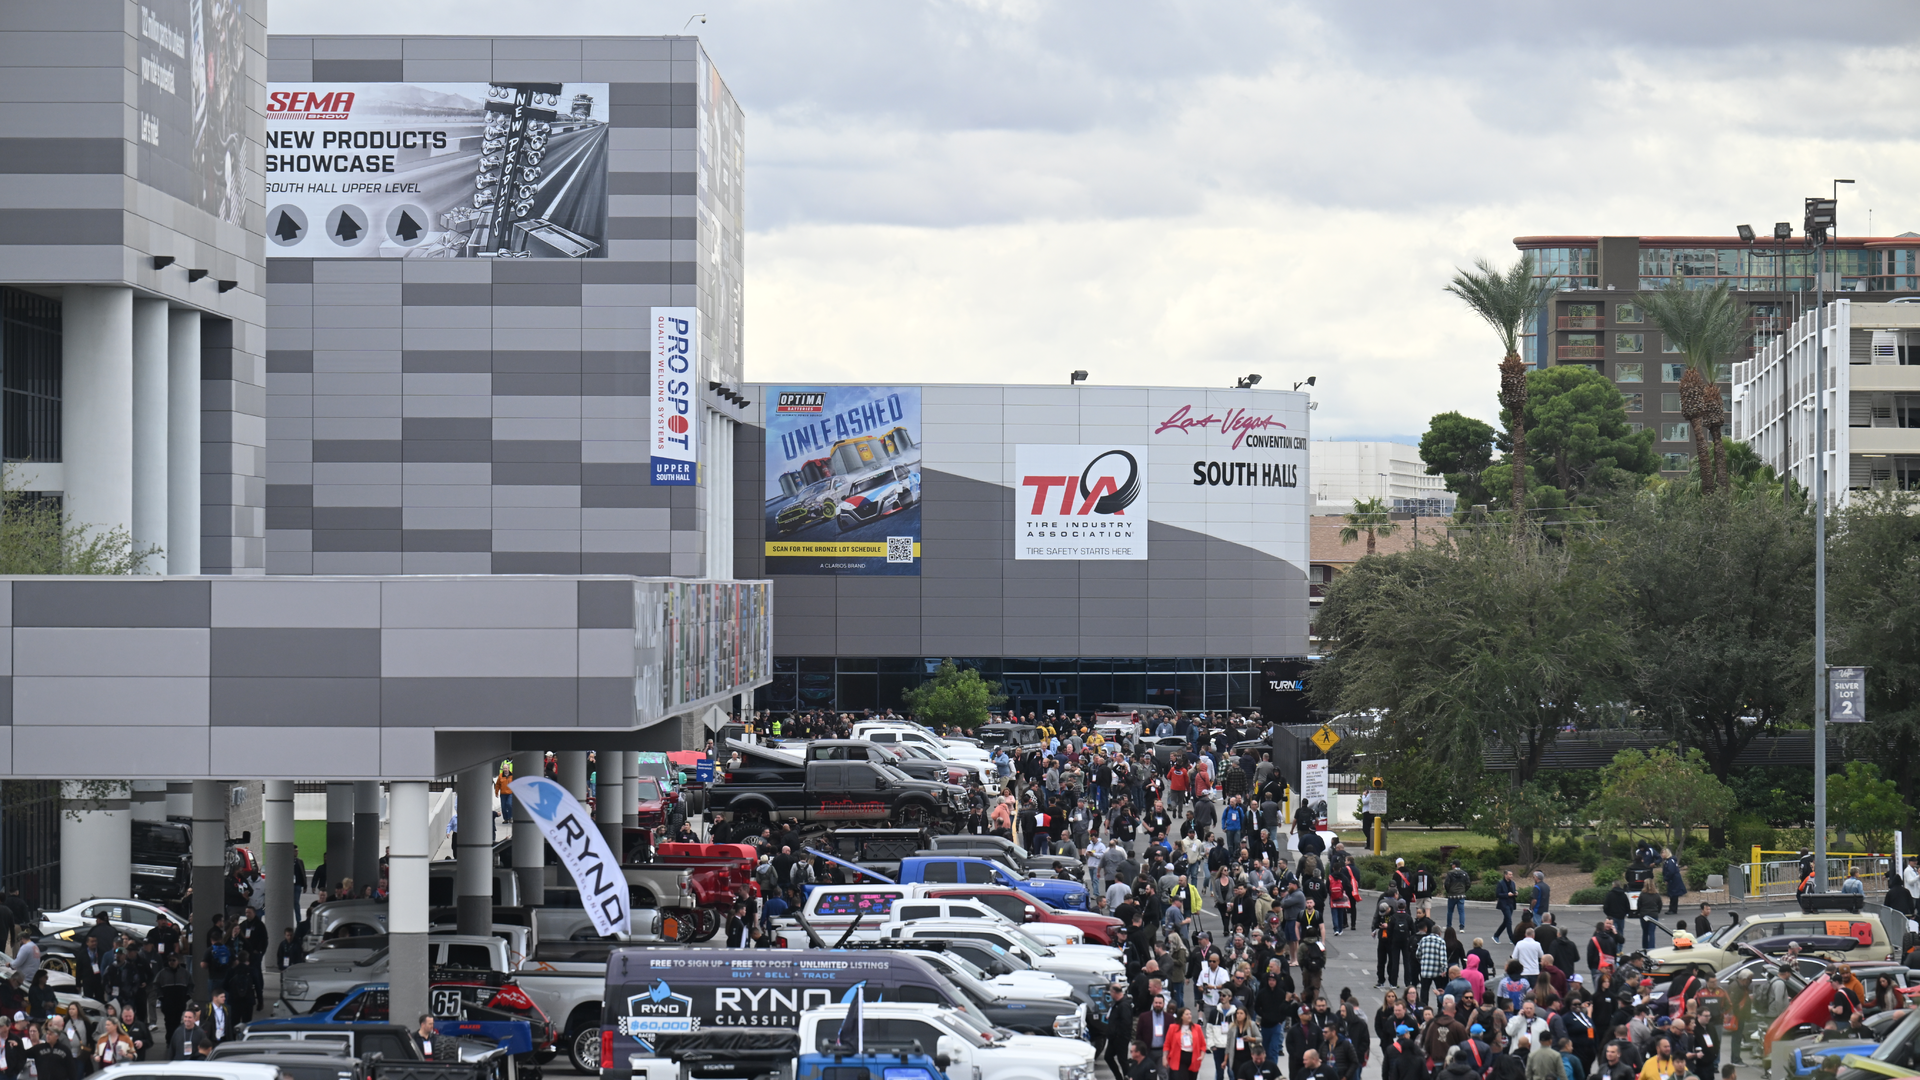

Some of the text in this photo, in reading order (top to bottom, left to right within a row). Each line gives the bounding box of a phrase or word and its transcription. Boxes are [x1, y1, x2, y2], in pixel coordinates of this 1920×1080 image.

[266, 91, 355, 112] SEMA
[266, 131, 447, 149] NEW PRODUCTS
[266, 154, 395, 173] SHOWCASE
[494, 92, 526, 237] NEW PRODUCTS
[265, 182, 421, 193] SOUTH HALL UPPER LEVEL
[668, 316, 689, 374] PRO
[657, 316, 665, 450] QUALITY WELDING SYSTEMS
[780, 394, 822, 405] OPTIMA
[781, 392, 904, 461] UNLEASHED
[1221, 408, 1287, 450] Vegas
[1245, 434, 1307, 450] CONVENTION CENT
[656, 464, 690, 473] UPPER
[1193, 461, 1297, 488] SOUTH HALLS
[1022, 476, 1125, 515] TIA
[772, 545, 789, 553] SCAN
[789, 545, 801, 553] FOR
[1026, 547, 1134, 556] TIRE SAFETY STARTS HERE.
[1834, 682, 1859, 690] SILVER
[1841, 700, 1853, 715] 2
[556, 813, 624, 926] RYNO
[586, 894, 610, 934] ONLINE
[800, 961, 848, 969] UNLIMITED
[433, 991, 460, 1016] 65
[641, 1004, 680, 1013] RYNO
[716, 988, 831, 1012] RYNO
[630, 1020, 690, 1032] $60,000
